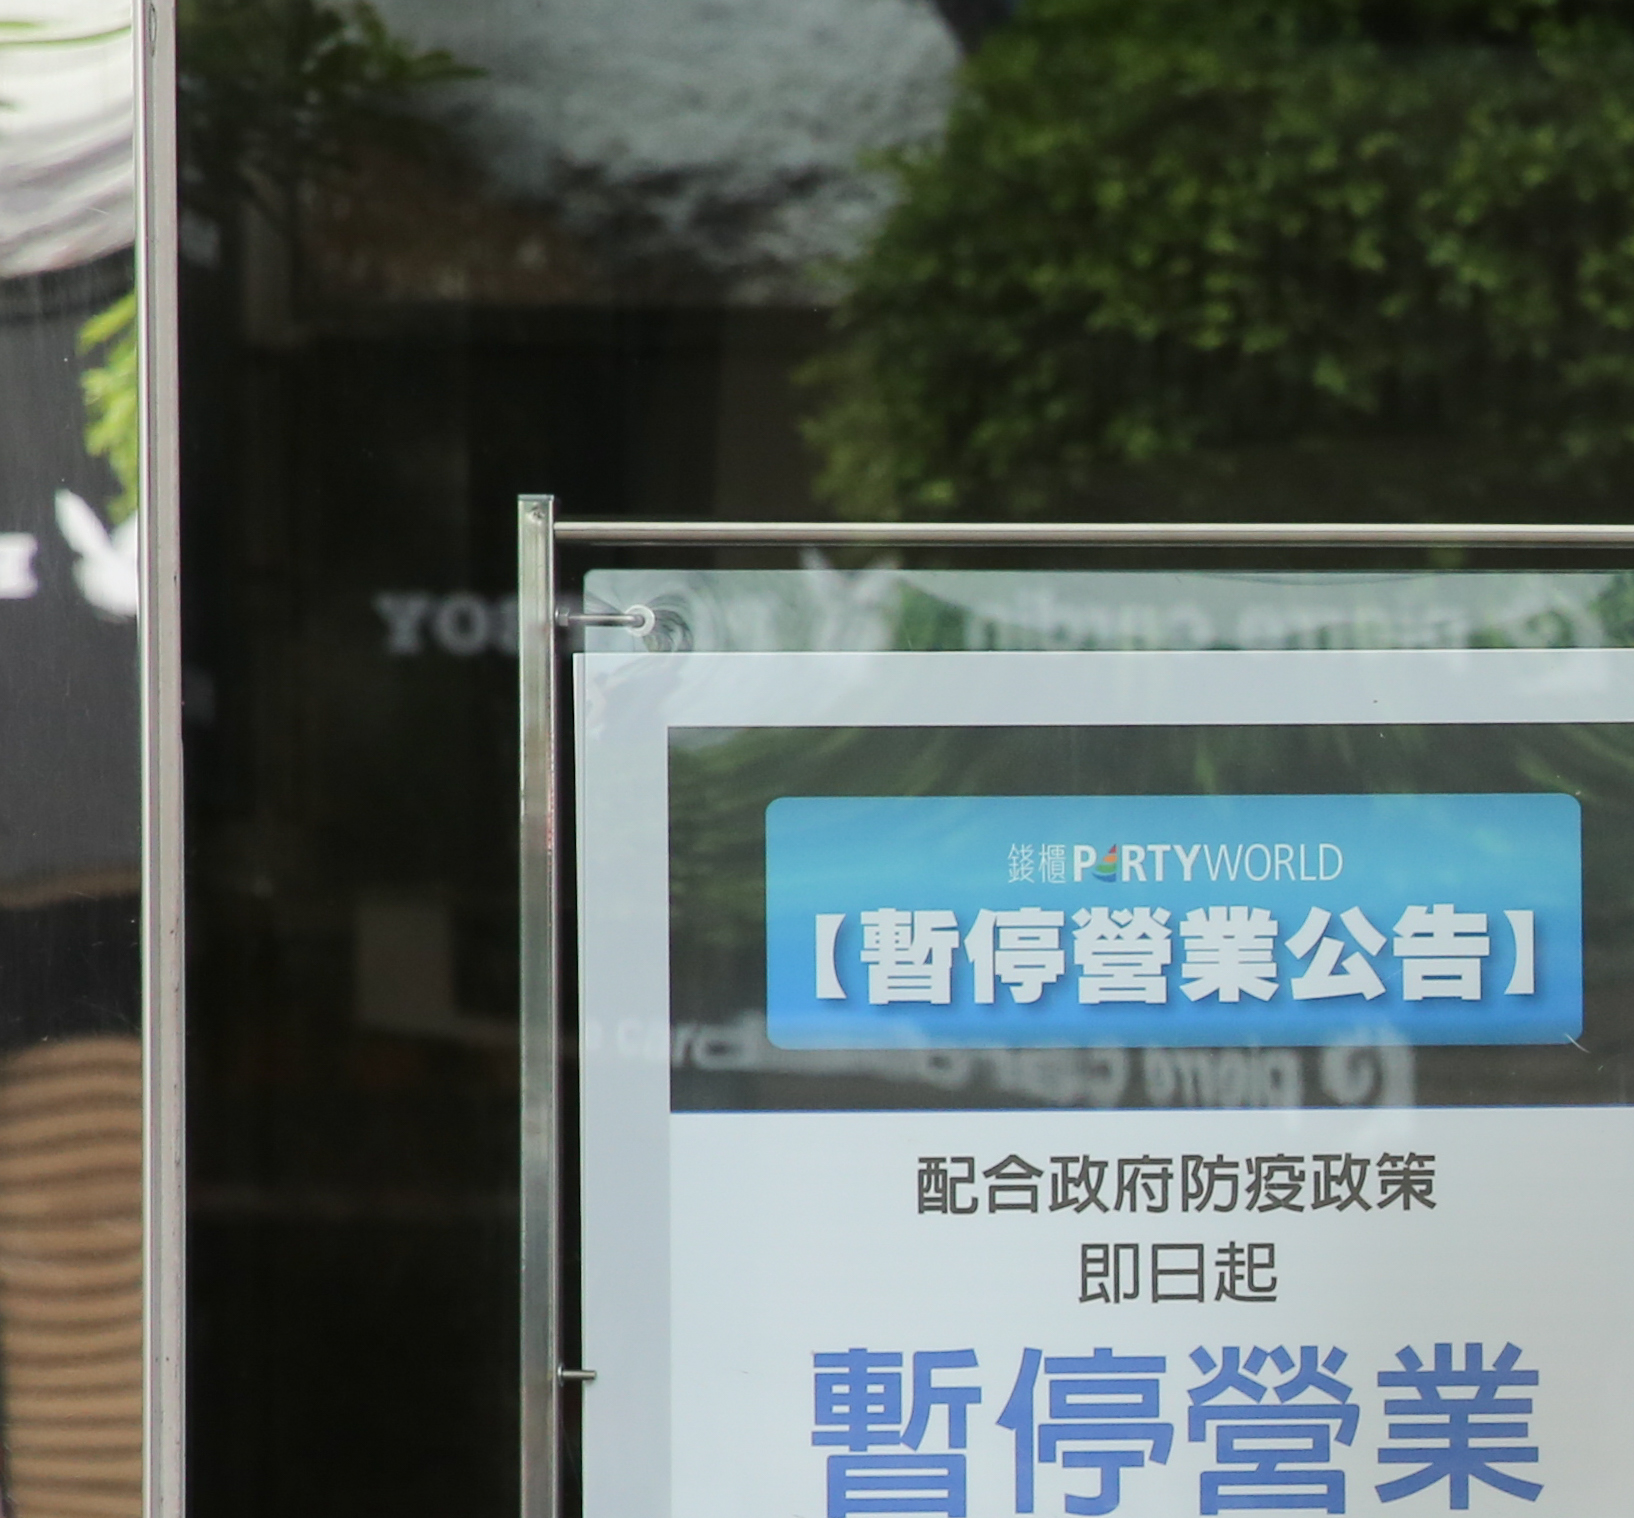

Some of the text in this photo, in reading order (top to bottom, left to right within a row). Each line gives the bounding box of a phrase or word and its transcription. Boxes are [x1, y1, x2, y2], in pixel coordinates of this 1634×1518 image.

[1007, 844, 1065, 884] 錢櫃
[815, 905, 1536, 1006] 【暫停營業公告】
[917, 1154, 1437, 1214] 配合政府防疫政策
[1078, 1242, 1279, 1304] 即日起
